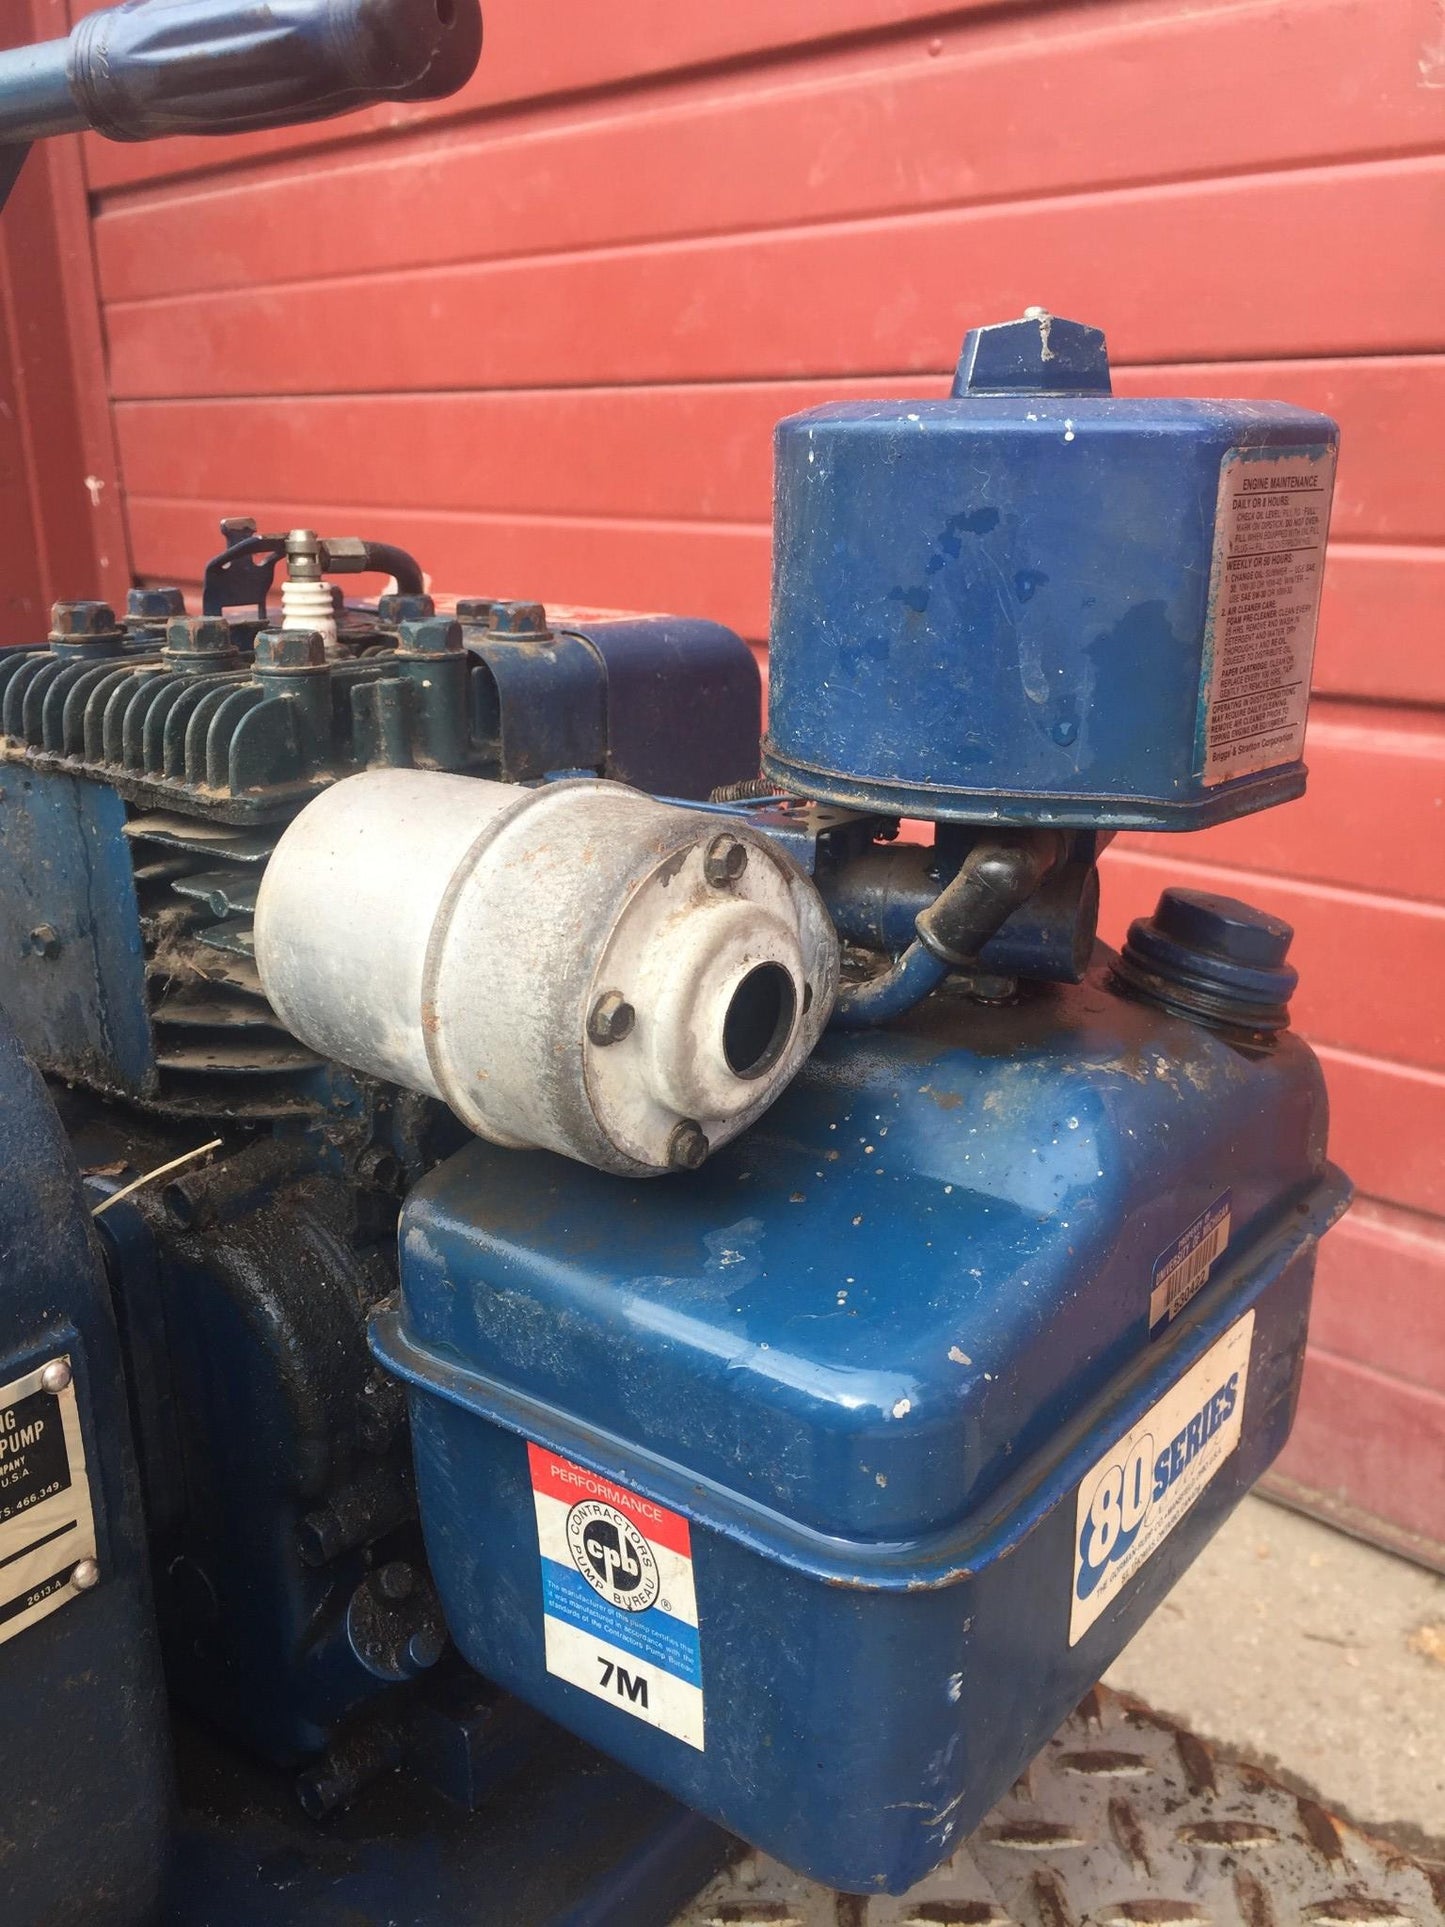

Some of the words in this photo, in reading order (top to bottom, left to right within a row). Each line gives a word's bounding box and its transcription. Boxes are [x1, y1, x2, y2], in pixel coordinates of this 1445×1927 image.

[1242, 477, 1269, 489] ENGINE
[1270, 475, 1318, 488] MAINTENANCE
[1232, 498, 1250, 509] DAILY
[1252, 497, 1260, 507] OR
[1267, 496, 1289, 506] HOURS:
[1236, 511, 1254, 521] CHECK
[1256, 510, 1264, 519] OIL
[1236, 522, 1251, 531] MARK
[1284, 518, 1292, 527] DO
[1293, 517, 1303, 526] NOT
[1234, 533, 1246, 542] FILL
[1247, 531, 1263, 541] WHEN
[1263, 529, 1287, 539] EQUIPPED
[1309, 526, 1319, 535] FILL
[1226, 557, 1252, 570] WEEKLY
[1253, 556, 1262, 567] OR
[1263, 555, 1270, 566] 50
[1271, 553, 1294, 565] HOURS:
[1231, 570, 1253, 581] CHANGE
[1305, 563, 1315, 572] SAE
[1240, 591, 1251, 601] SAE
[1226, 614, 1241, 625] FOAM
[1278, 606, 1294, 617] CLEAN
[1295, 604, 1311, 614] EVERY
[1228, 606, 1236, 615] AIR
[1237, 602, 1261, 614] CLEANER
[1245, 621, 1266, 632] REMOVE
[1268, 619, 1278, 628] AND
[1279, 616, 1293, 626] WASH
[1223, 641, 1258, 656] THOROUGHLY
[1259, 639, 1270, 649] AND
[1224, 632, 1254, 646] DETERGENT
[1255, 630, 1266, 640] AND
[1222, 654, 1245, 666] SQUEEZE
[1246, 652, 1253, 661] TO
[1254, 646, 1282, 659] DISTRIBUTE
[1222, 666, 1238, 677] PAPER
[1269, 656, 1285, 667] CLEAN
[1219, 686, 1239, 698] GENTLY
[1248, 679, 1268, 691] REMOVE
[1220, 675, 1243, 688] REPLACE
[1244, 671, 1261, 683] EVERY
[1212, 699, 1241, 713] OPERATING
[1243, 697, 1248, 706] IN
[1249, 694, 1265, 705] DUSTY
[1266, 687, 1295, 701] CONDITIONS
[1210, 720, 1232, 733] REMOVE
[1233, 718, 1241, 728] AIR
[1243, 712, 1265, 725] CLEANER
[1266, 708, 1280, 719] PRIOR
[1211, 713, 1223, 723] MAY
[1224, 708, 1246, 720] REQUIRE
[1246, 704, 1261, 715] DAILY
[1209, 730, 1230, 743] TIPPING
[1231, 725, 1250, 738] ENGINE
[1250, 723, 1258, 732] OR
[1212, 748, 1230, 764] Briggs
[1232, 746, 1236, 756] &
[1237, 740, 1260, 754] Stratton
[1261, 731, 1293, 749] Corporation
[1156, 1241, 1189, 1286] UNIVERSITY
[1202, 1202, 1228, 1239] MICHIGAN
[0, 1420, 44, 1459] PUMP
[1079, 1433, 1154, 1590] 80
[1152, 1372, 1240, 1504] SERIES
[550, 1465, 663, 1523] PERFORMANCE
[571, 1504, 653, 1568] CONTRACTORS
[586, 1524, 639, 1586] cpb
[573, 1544, 604, 1590] PUMP
[613, 1578, 655, 1608] BUREAU
[26, 1580, 62, 1606] 2613-A
[548, 1579, 558, 1590] The
[561, 1585, 605, 1612] manufacturer
[615, 1611, 628, 1623] this
[630, 1619, 650, 1635] pump
[651, 1628, 678, 1647] certifies
[680, 1642, 693, 1654] that
[548, 1598, 580, 1619] standards
[591, 1618, 601, 1630] the
[604, 1624, 642, 1649] Contractors
[645, 1644, 665, 1661] Pump
[554, 1592, 567, 1603] was
[568, 1599, 613, 1625] manufactured
[624, 1625, 662, 1649] accordance
[665, 1645, 680, 1657] with
[682, 1653, 694, 1664] the
[597, 1656, 649, 1709] 7M
